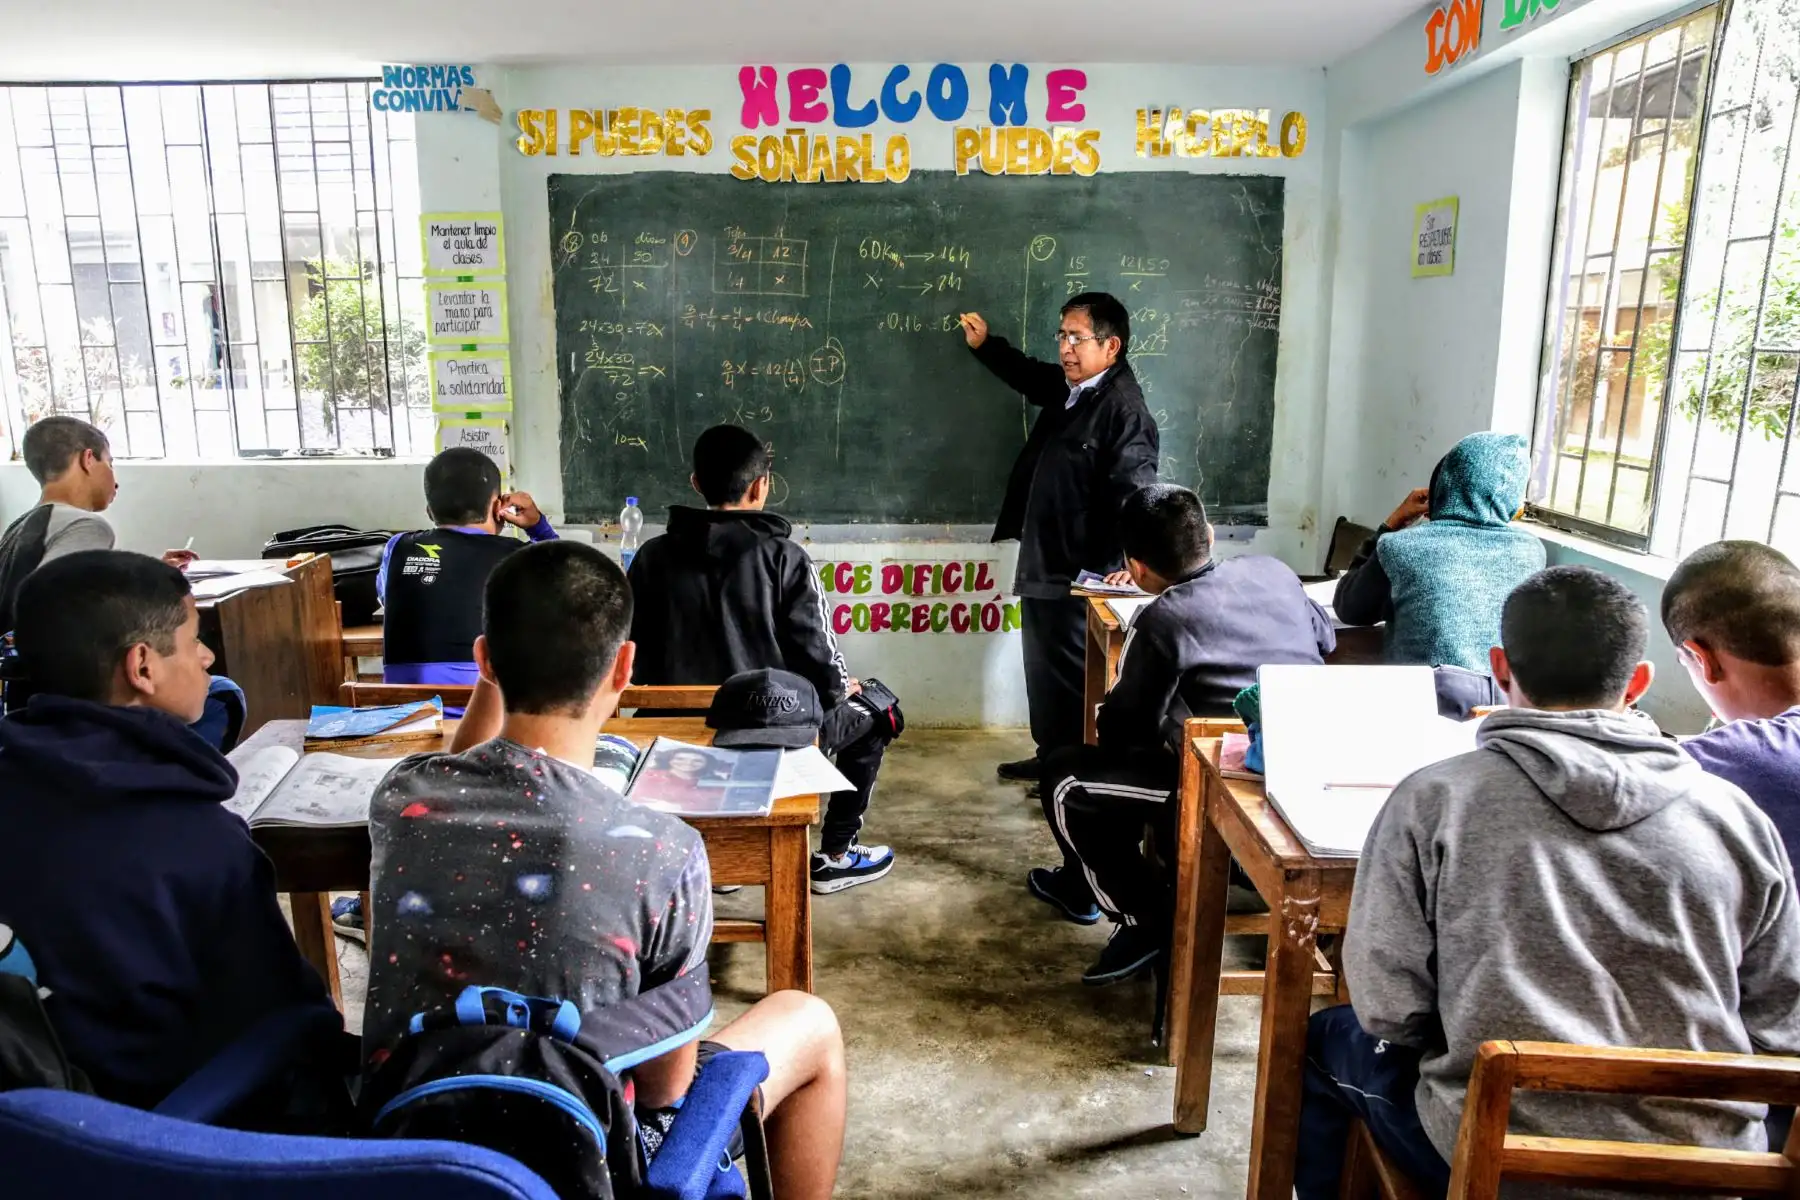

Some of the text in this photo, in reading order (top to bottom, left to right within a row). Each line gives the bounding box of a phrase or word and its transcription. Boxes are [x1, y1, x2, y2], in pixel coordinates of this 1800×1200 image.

[382, 65, 475, 88] NORMAS
[373, 89, 477, 112] CONVIV
[738, 63, 1087, 129] WELCOME
[516, 106, 714, 157] SI PUEDES
[1136, 108, 1307, 158] HACERLO
[729, 126, 1100, 183] SOÑARLO PUEDES
[431, 222, 497, 239] Mantener limpio
[443, 236, 488, 250] el aula de
[438, 290, 490, 306] Levantar la
[445, 306, 493, 321] mano para
[435, 320, 481, 335] participar
[437, 377, 508, 396] la solidaridad
[460, 428, 490, 441] Asistir
[881, 561, 994, 595] DIFICIL
[833, 594, 1022, 635] CORRECCIÓN
